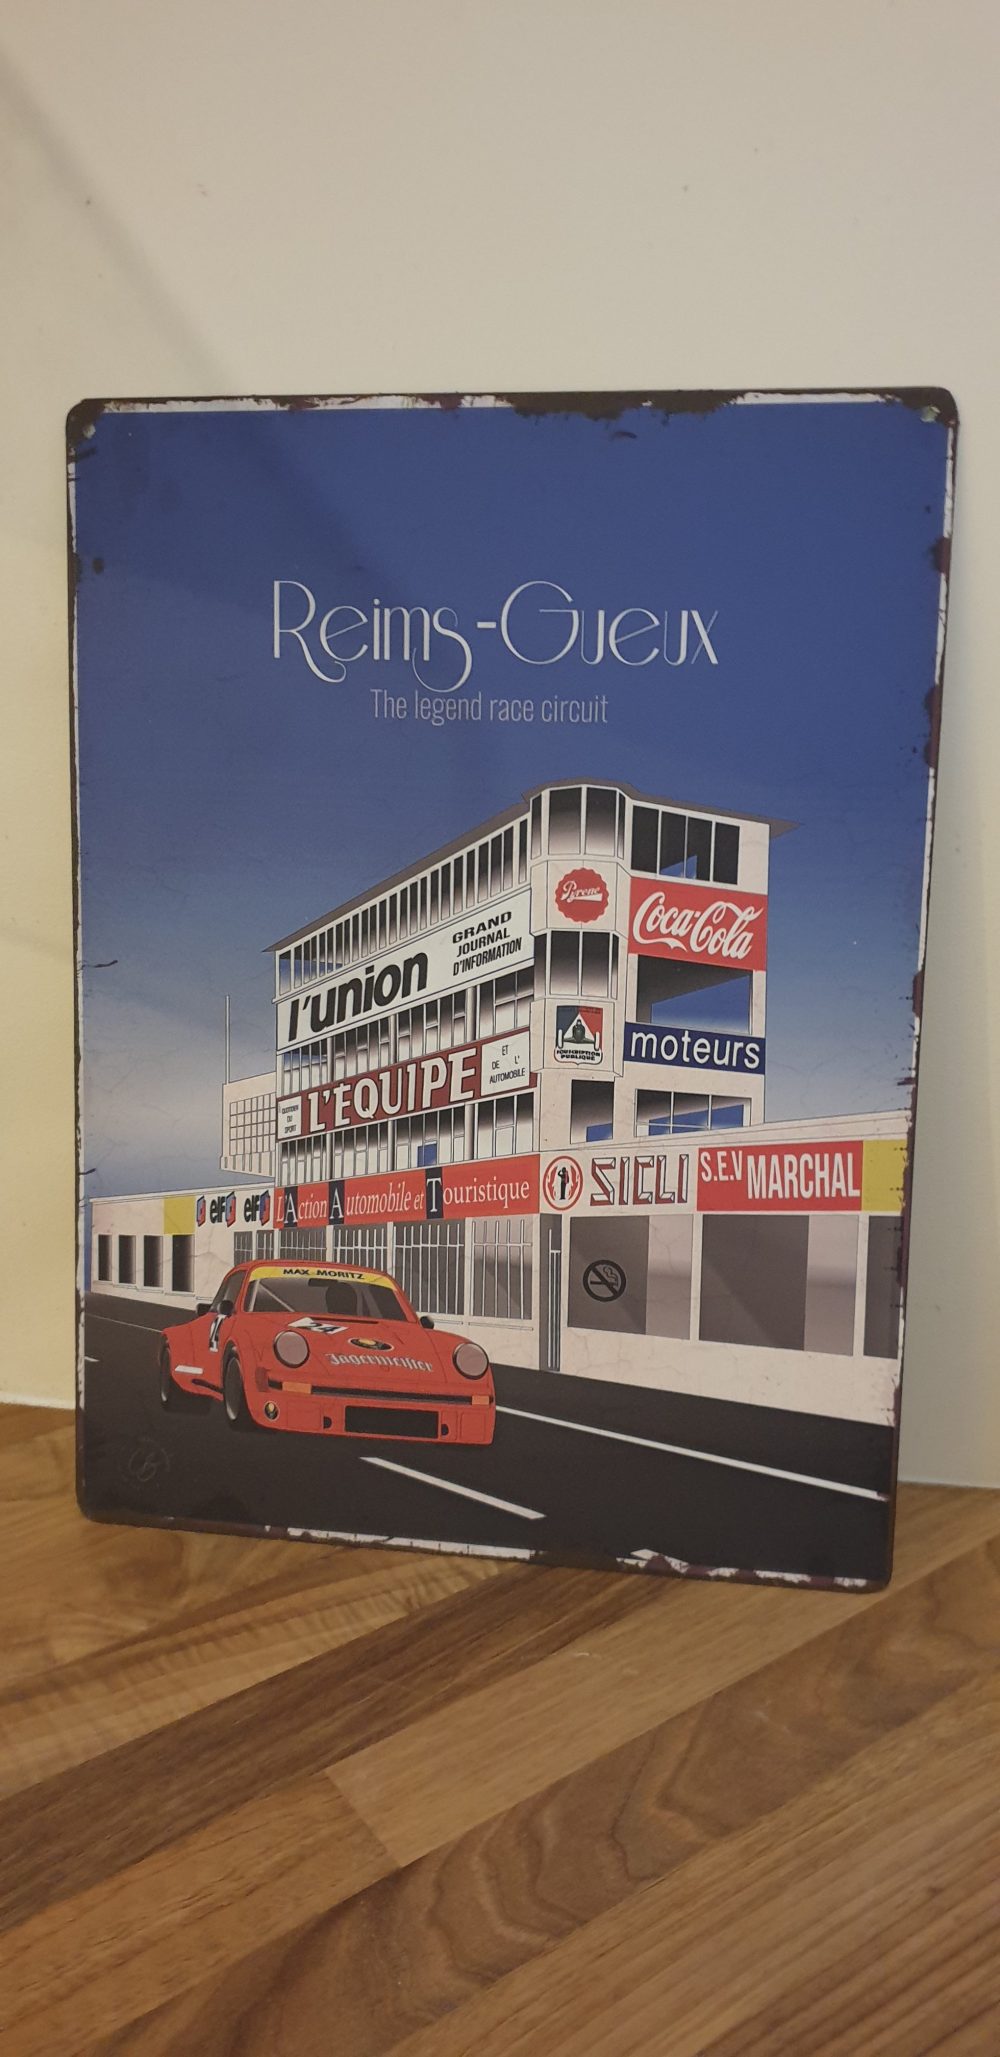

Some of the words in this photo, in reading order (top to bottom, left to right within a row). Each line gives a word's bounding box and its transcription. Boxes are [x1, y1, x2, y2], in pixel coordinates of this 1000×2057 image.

[370, 689, 407, 719] The
[415, 690, 482, 726] legend
[490, 699, 534, 721] race
[541, 695, 608, 723] circuit
[452, 911, 512, 943] GRAND
[456, 927, 511, 957] JOURNAL
[633, 891, 763, 959] Coca-Cola
[452, 937, 522, 976] D'INFORMATION
[288, 952, 428, 1042] l'union
[491, 1060, 500, 1070] DE
[501, 1044, 509, 1056] ET
[630, 1030, 760, 1069] moteurs
[489, 1067, 526, 1084] AUTOMOBILE
[590, 1153, 690, 1206] SICLI
[747, 1152, 861, 1199] MARCHAL
[209, 1196, 226, 1224] elf
[243, 1194, 260, 1223] elf
[413, 1194, 424, 1211] et
[426, 1177, 529, 1213] Touristique
[316, 1270, 365, 1280] MORITZ
